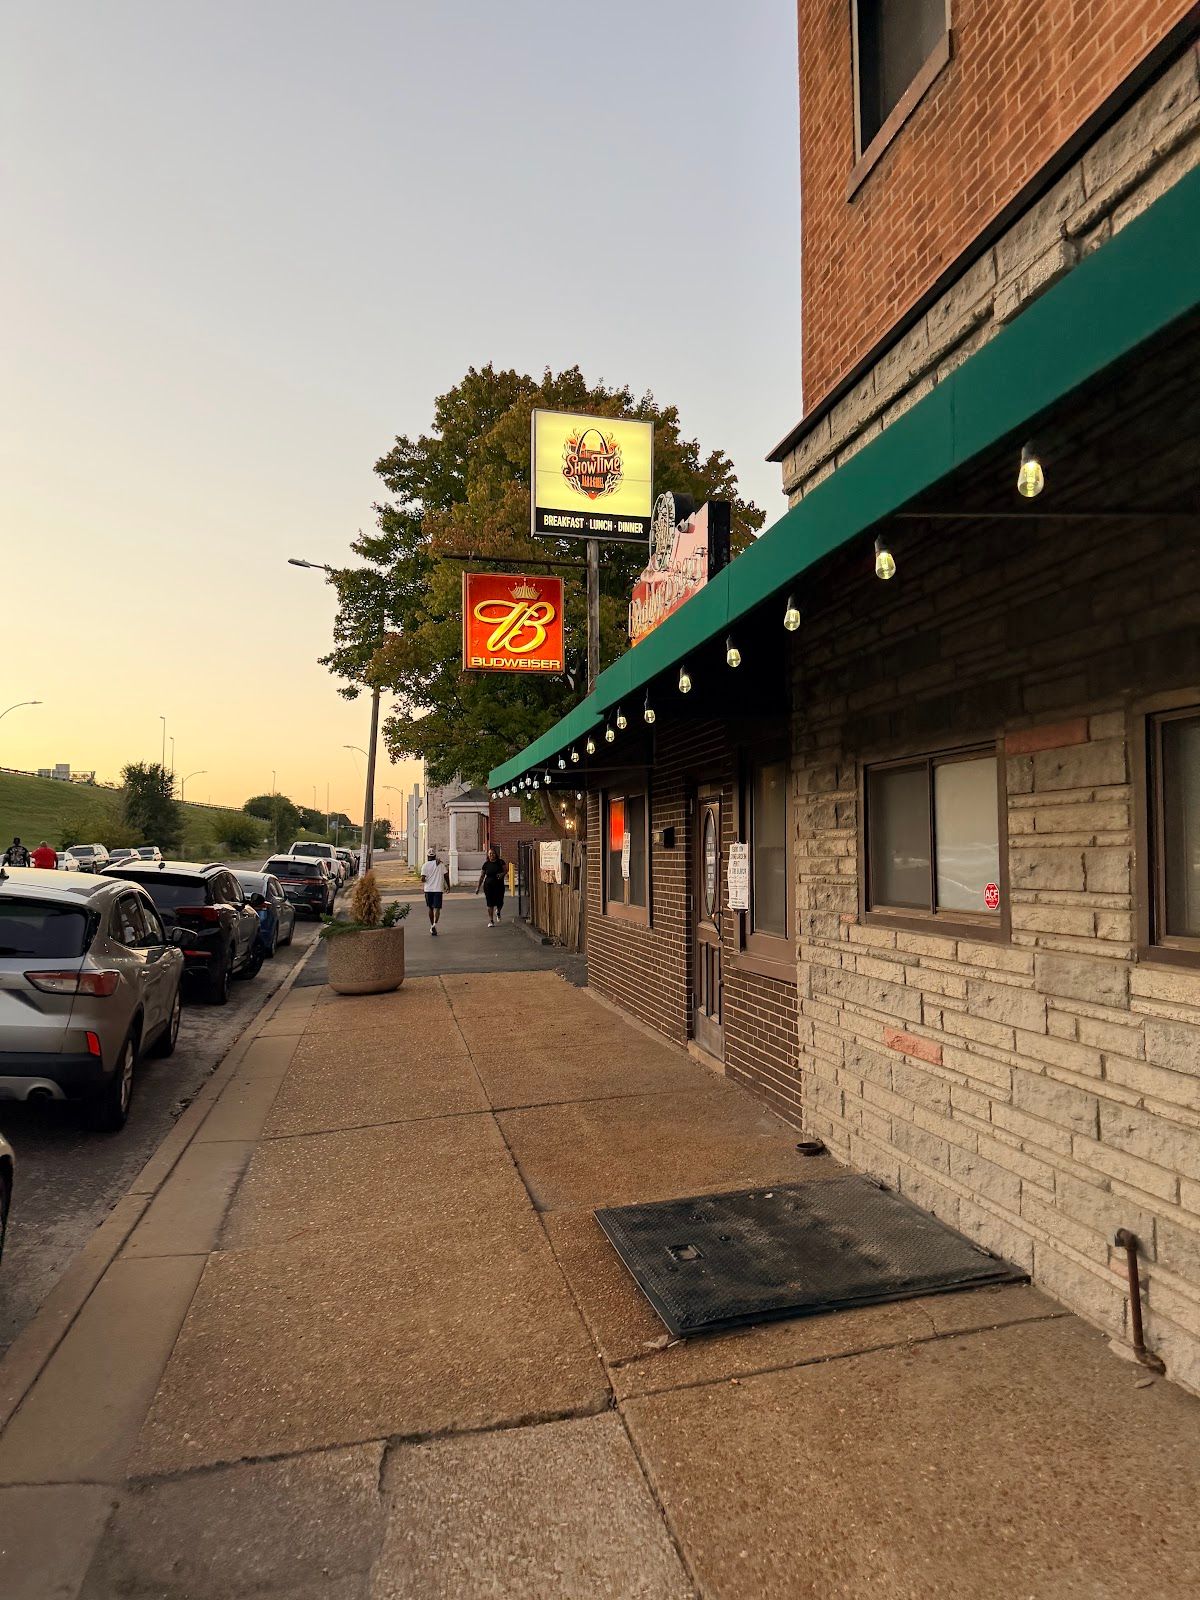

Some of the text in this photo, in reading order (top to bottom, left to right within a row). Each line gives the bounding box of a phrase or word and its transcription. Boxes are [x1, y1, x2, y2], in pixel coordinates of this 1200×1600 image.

[543, 514, 644, 534] BREAKFAST LUNCH DINNER
[471, 656, 560, 669] BUDWEISER
